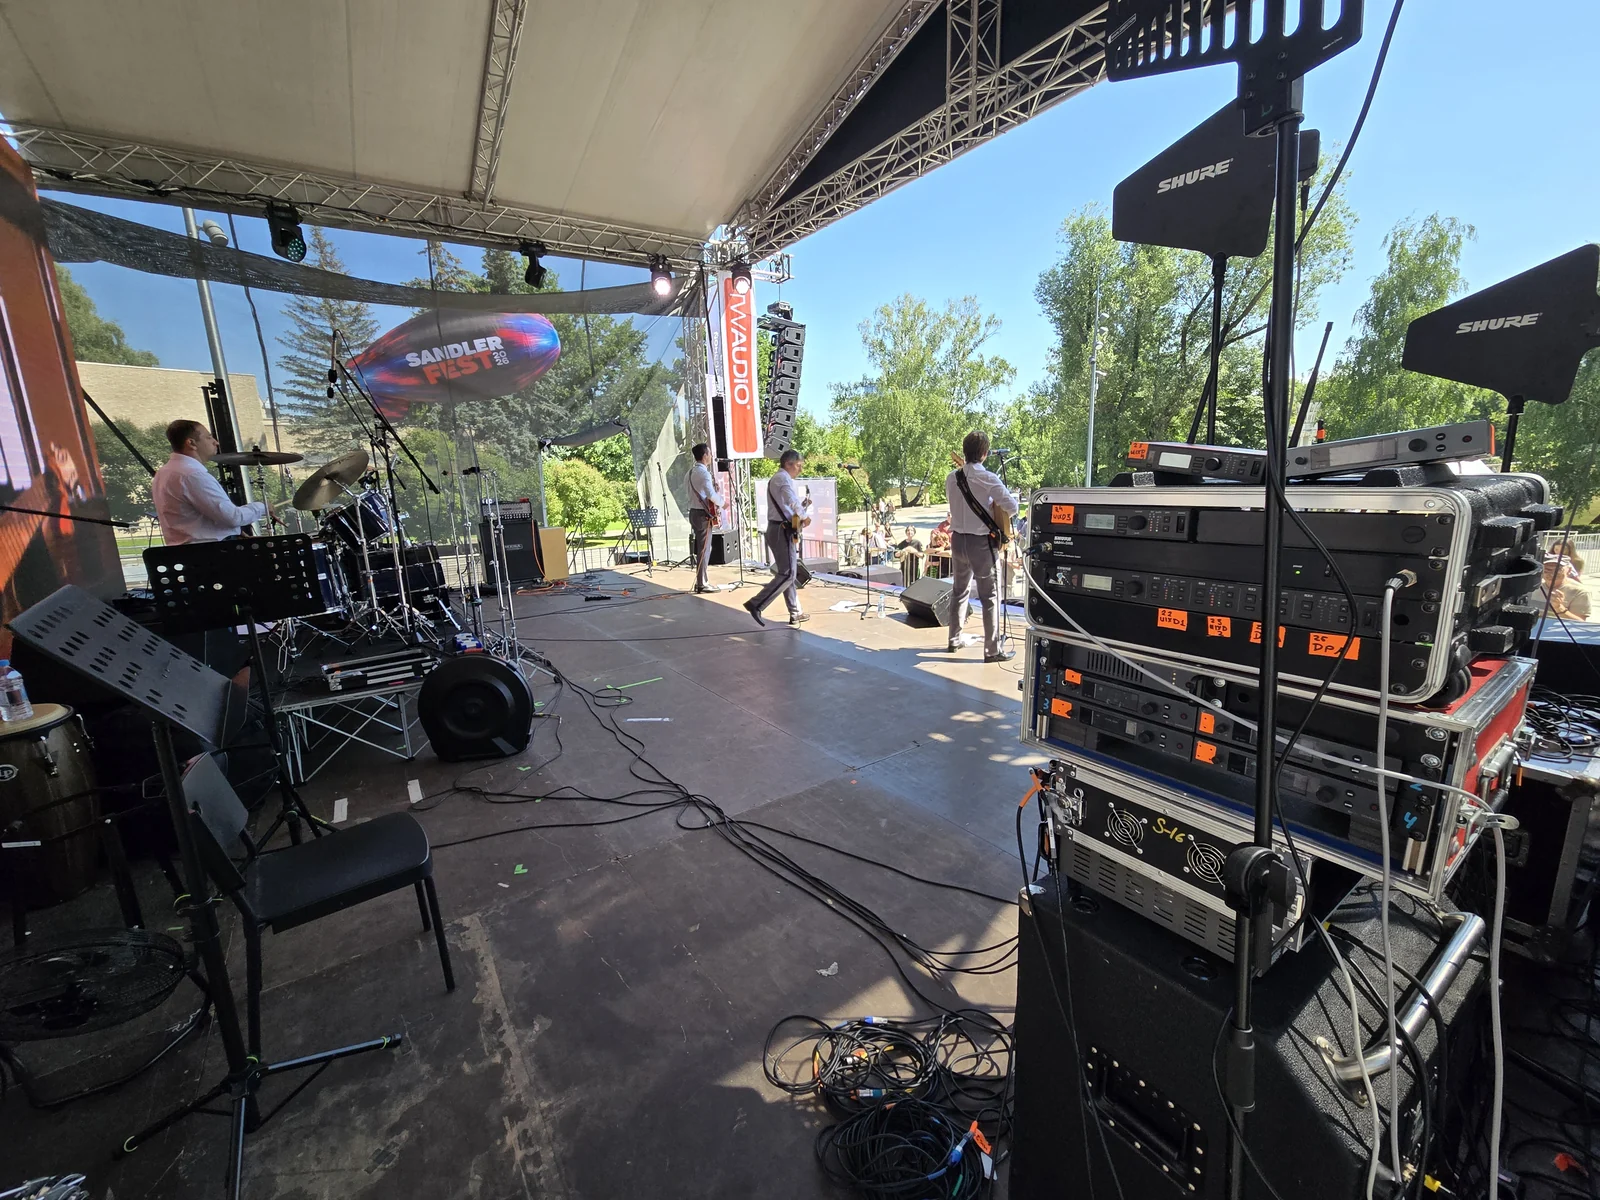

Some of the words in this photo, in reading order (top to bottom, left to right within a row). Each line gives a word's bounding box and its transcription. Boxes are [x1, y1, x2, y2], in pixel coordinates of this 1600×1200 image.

[1157, 159, 1231, 194] SHURE
[1456, 313, 1539, 334] SHURE
[405, 336, 504, 368] SANDLER
[422, 350, 494, 385] FEST
[1161, 609, 1173, 617] 22
[1045, 674, 1052, 684] 1
[1043, 697, 1050, 710] 3
[1152, 817, 1186, 843] S-16
